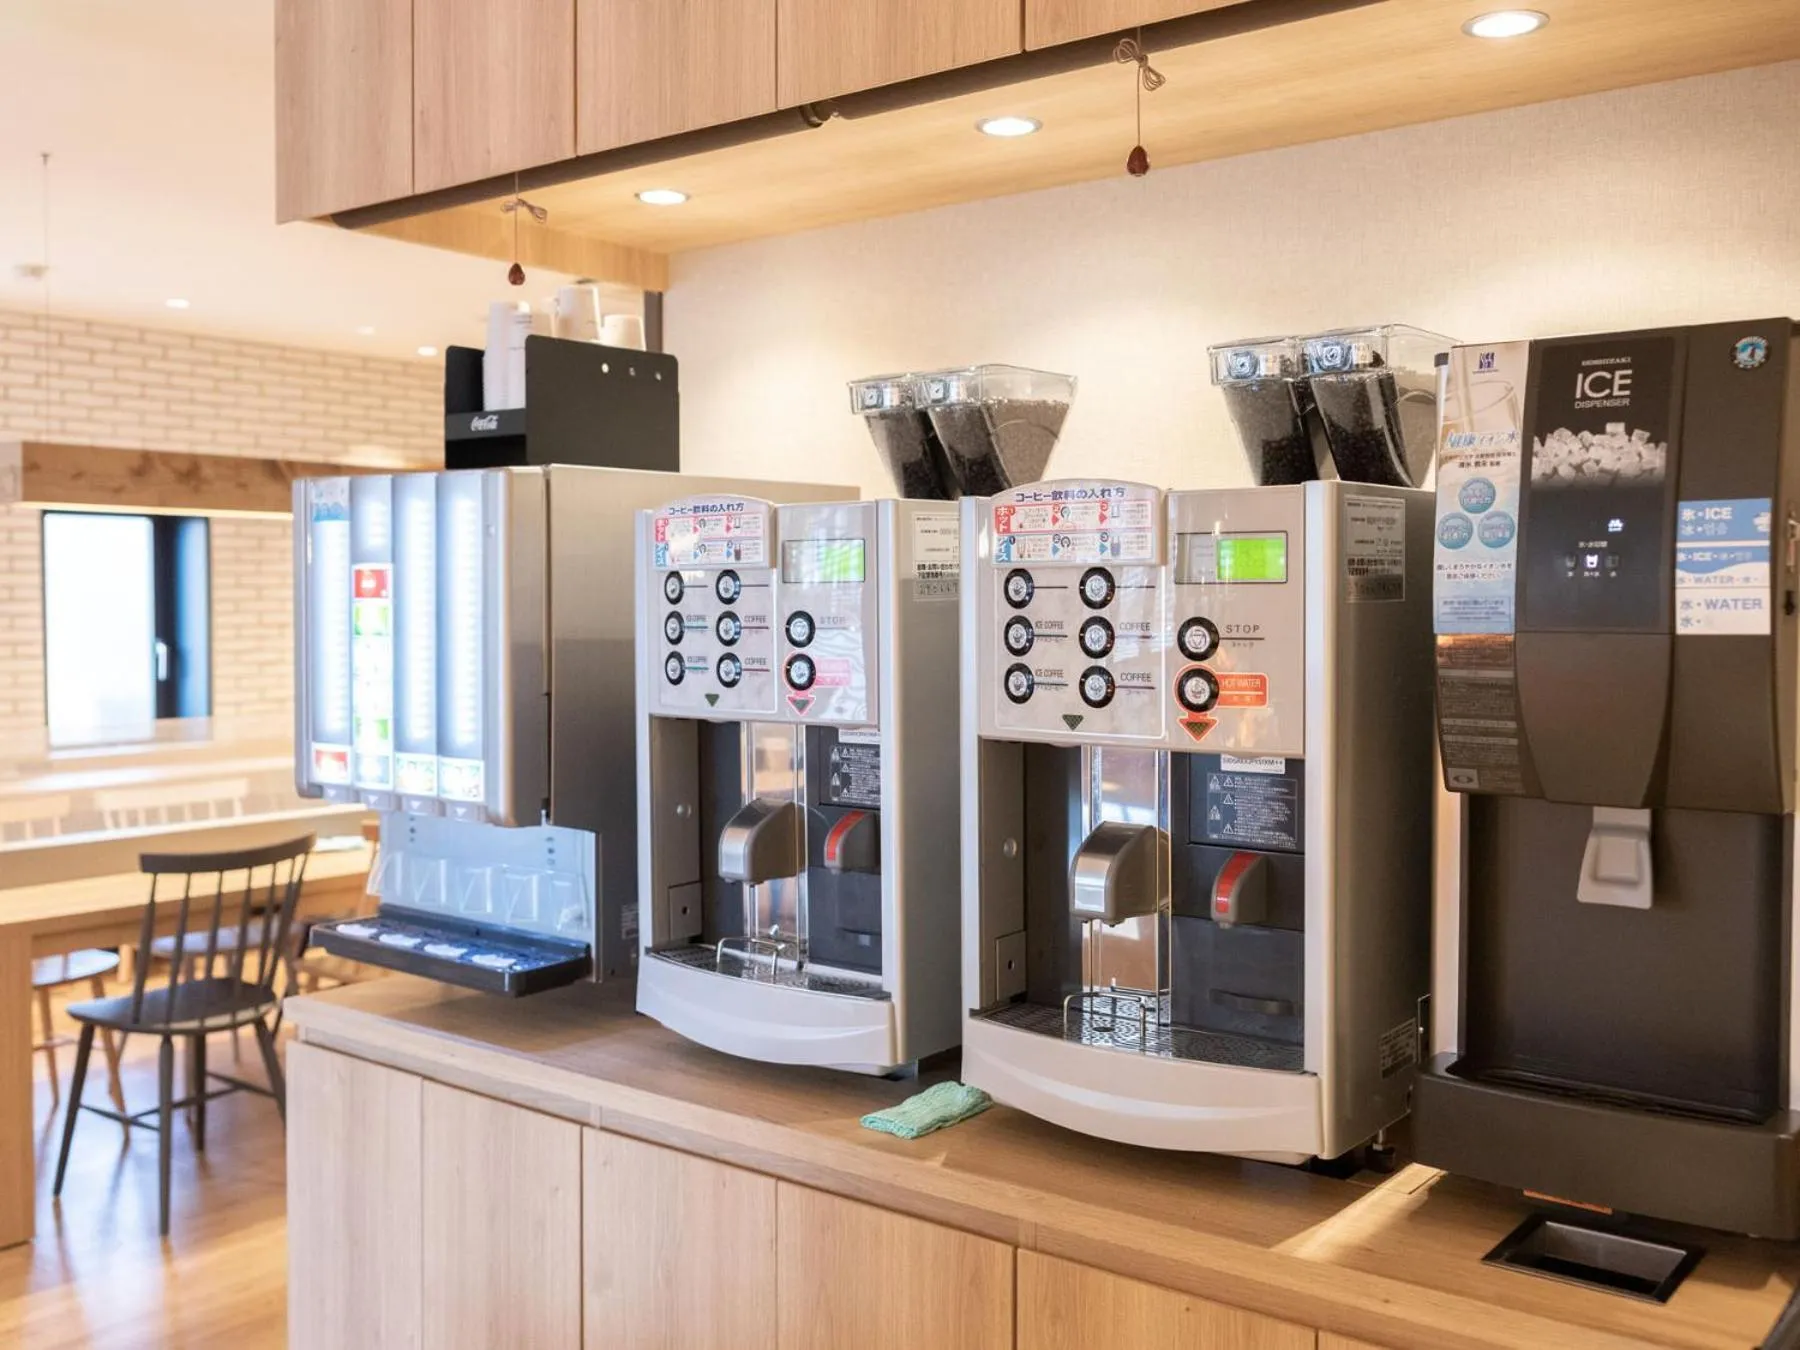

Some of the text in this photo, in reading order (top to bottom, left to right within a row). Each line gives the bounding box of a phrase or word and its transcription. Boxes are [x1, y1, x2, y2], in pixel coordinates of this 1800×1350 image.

[1575, 369, 1633, 399] ICE
[1574, 398, 1631, 409] DISPENSER
[1015, 486, 1126, 502] コーヒー飲料の入れ方
[668, 502, 745, 516] コーヒー飲料の入れ方
[744, 615, 767, 624] COFFEE
[819, 616, 846, 625] STOP
[1043, 620, 1065, 630] COFFEE
[1119, 621, 1151, 632] COFFEE
[1225, 624, 1261, 634] STOP
[744, 657, 767, 667] COFFEE
[1043, 668, 1064, 679] COFFEE
[1119, 671, 1152, 682] COFFEE
